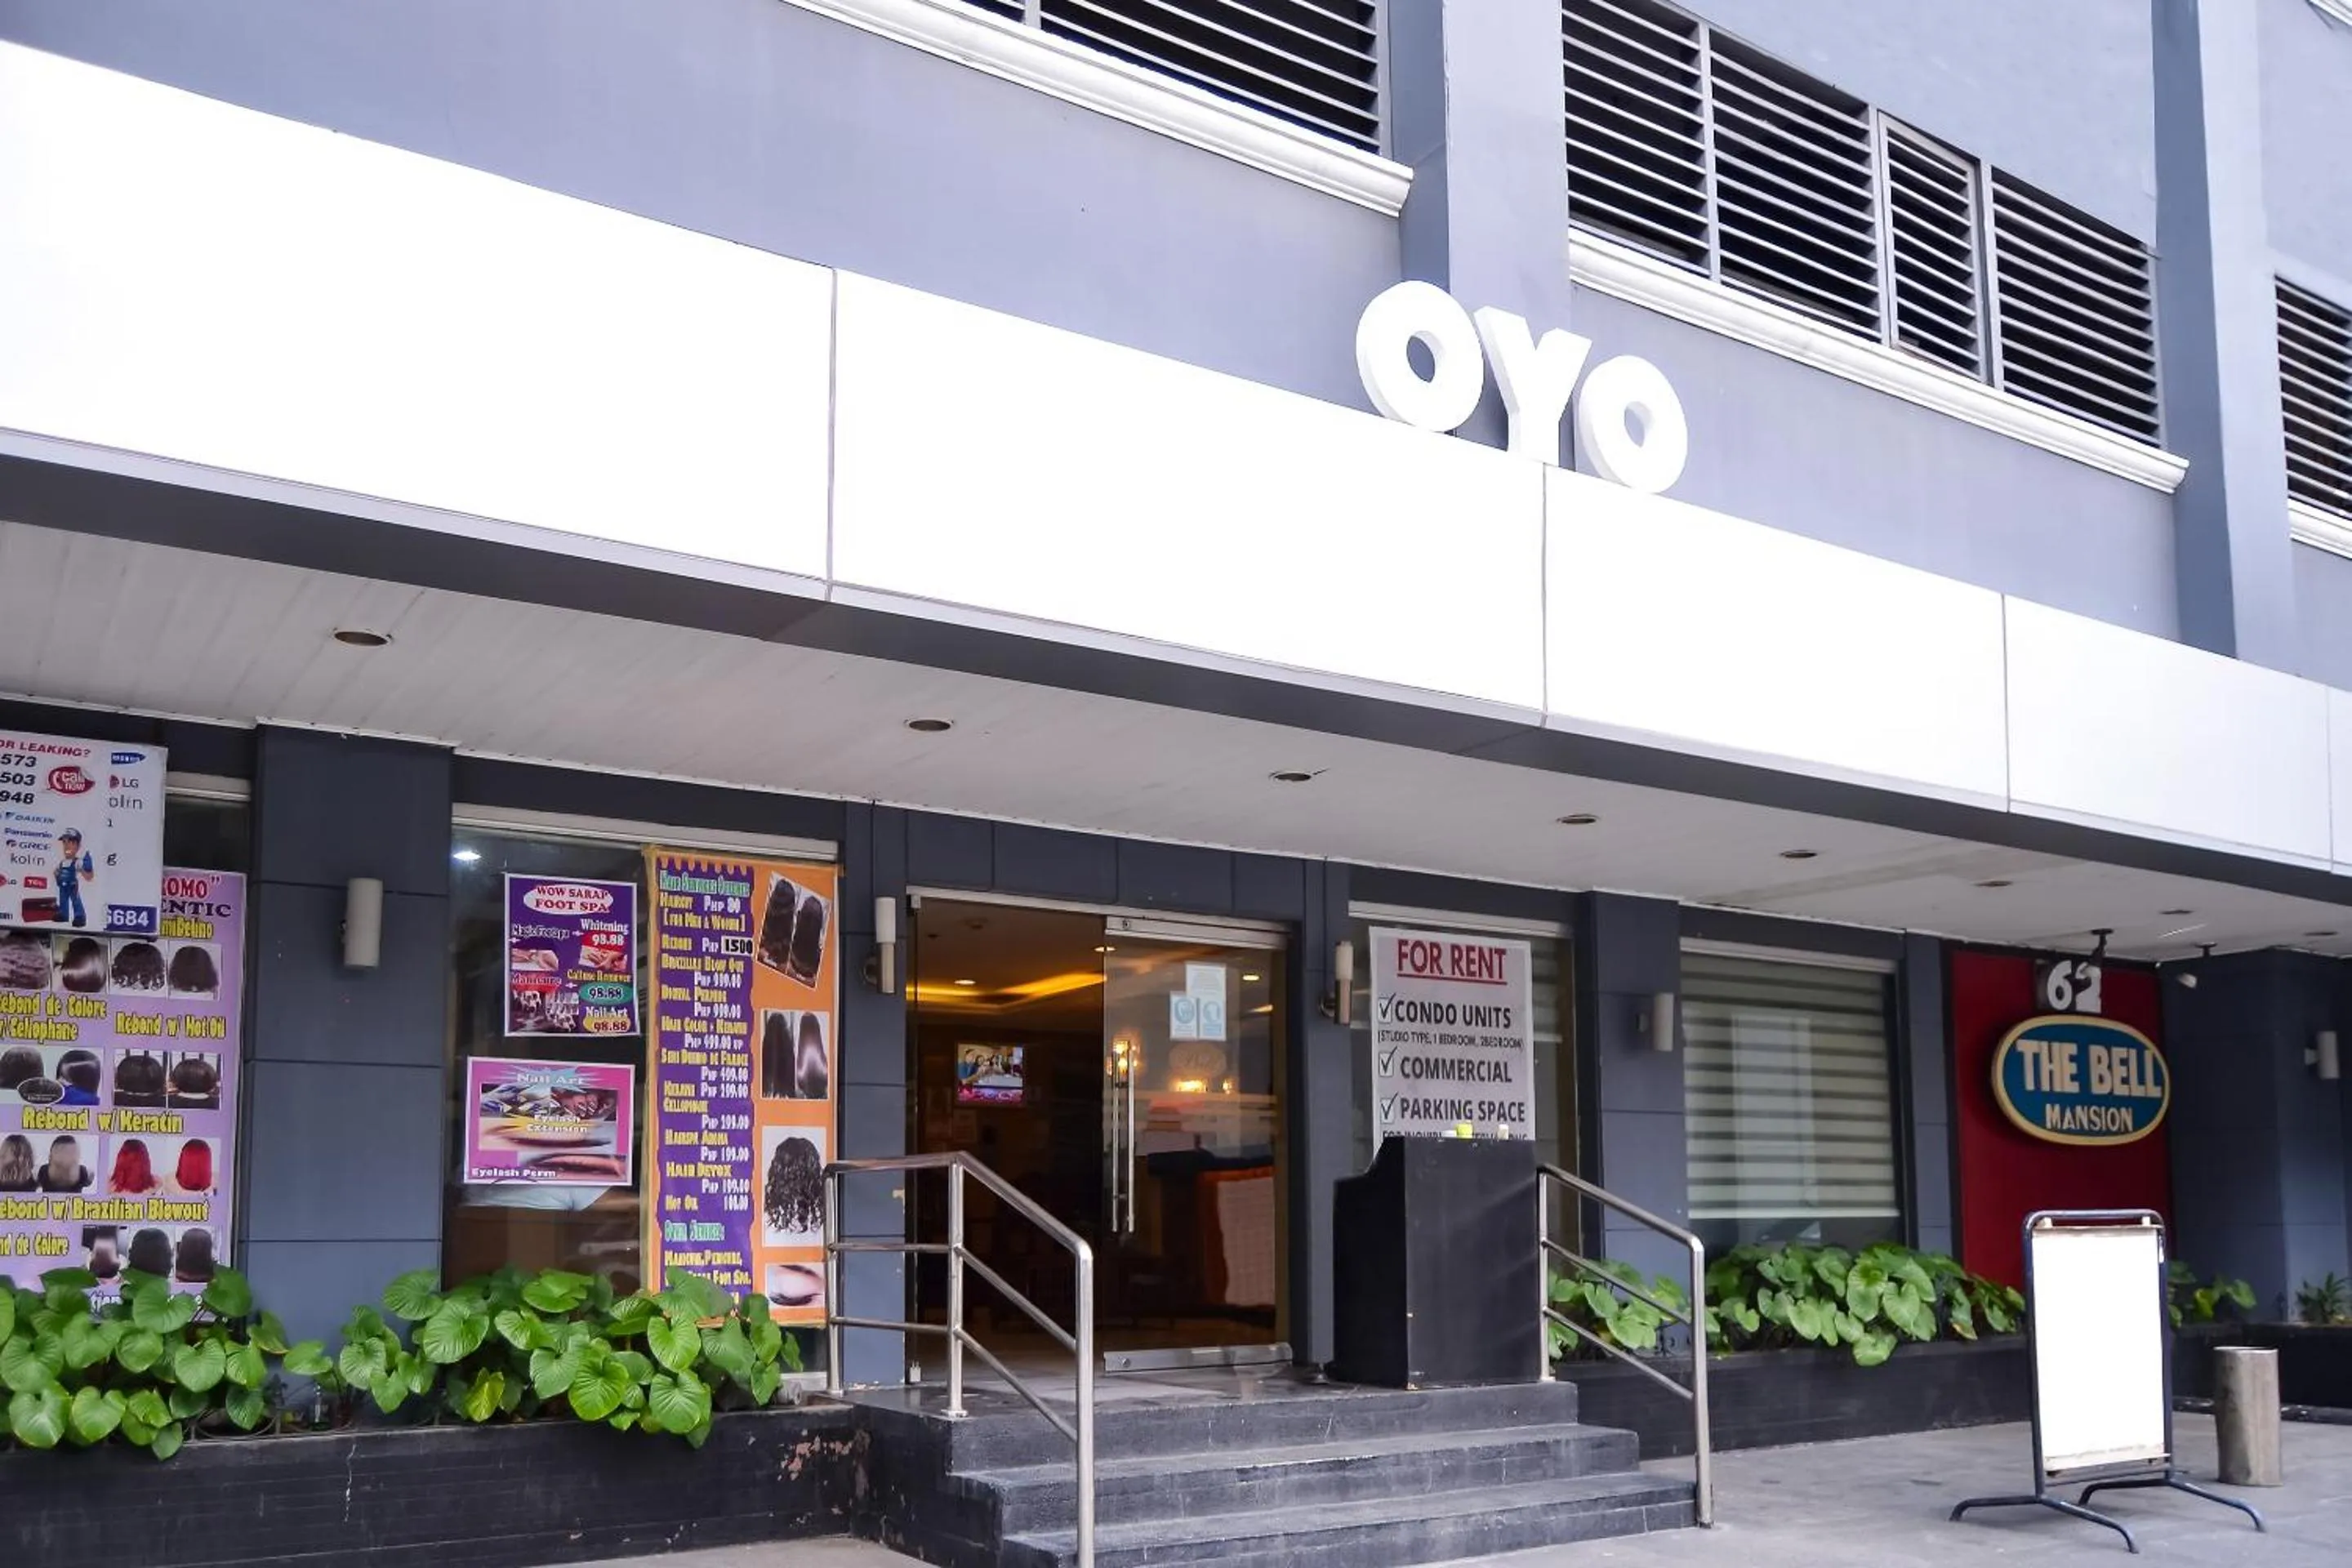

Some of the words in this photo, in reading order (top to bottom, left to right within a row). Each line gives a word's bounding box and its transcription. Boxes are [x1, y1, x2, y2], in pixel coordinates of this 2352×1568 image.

[1356, 280, 1688, 494] OYO
[20, 742, 91, 757] LEAKING?
[122, 777, 139, 790] LG
[537, 886, 568, 896] WOW
[568, 889, 608, 899] SARAP
[536, 900, 576, 910] FOOT
[580, 902, 610, 913] SPA
[581, 918, 630, 935] Whitening
[724, 938, 753, 954] 1500
[1397, 939, 1443, 975] FOR
[1450, 944, 1507, 980] RENT
[0, 990, 40, 1016] ebond
[1395, 1000, 1458, 1025] CONDO
[1463, 1005, 1512, 1029] UNITS
[115, 1011, 163, 1036] Rebond
[1400, 1056, 1512, 1084] COMMERCIAL
[2016, 1038, 2080, 1094] THE
[2087, 1044, 2163, 1098] BELL
[22, 1107, 89, 1132] Rebond
[118, 1108, 184, 1134] Keratin
[1401, 1098, 1473, 1121] PARKING
[1478, 1101, 1526, 1122] SPACE
[2044, 1102, 2134, 1133] MANSION
[471, 1167, 519, 1178] Eyelash
[523, 1169, 556, 1178] Perm
[0, 1196, 48, 1220] ebond
[72, 1196, 144, 1221] Brazilian
[147, 1199, 210, 1222] Blowout
